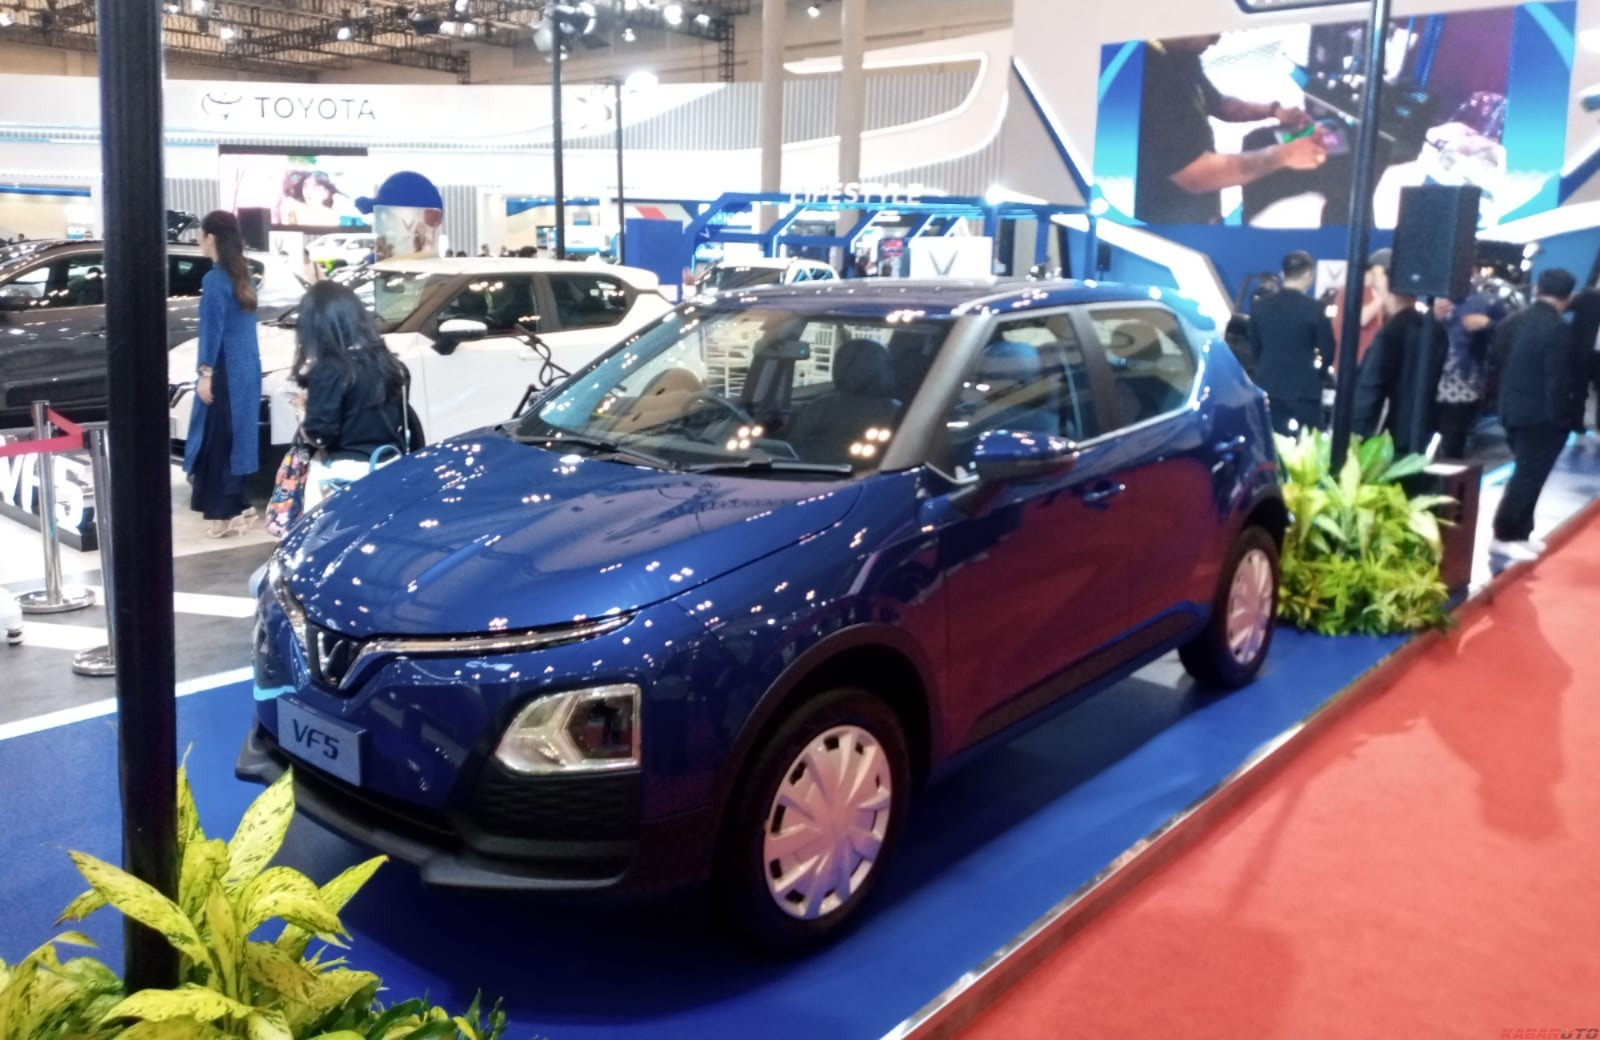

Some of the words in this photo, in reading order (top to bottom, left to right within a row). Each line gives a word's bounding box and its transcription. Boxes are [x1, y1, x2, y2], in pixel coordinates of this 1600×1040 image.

[254, 96, 376, 120] TOYOTA
[790, 182, 924, 204] LIFESTYLE
[293, 719, 339, 760] VF5
